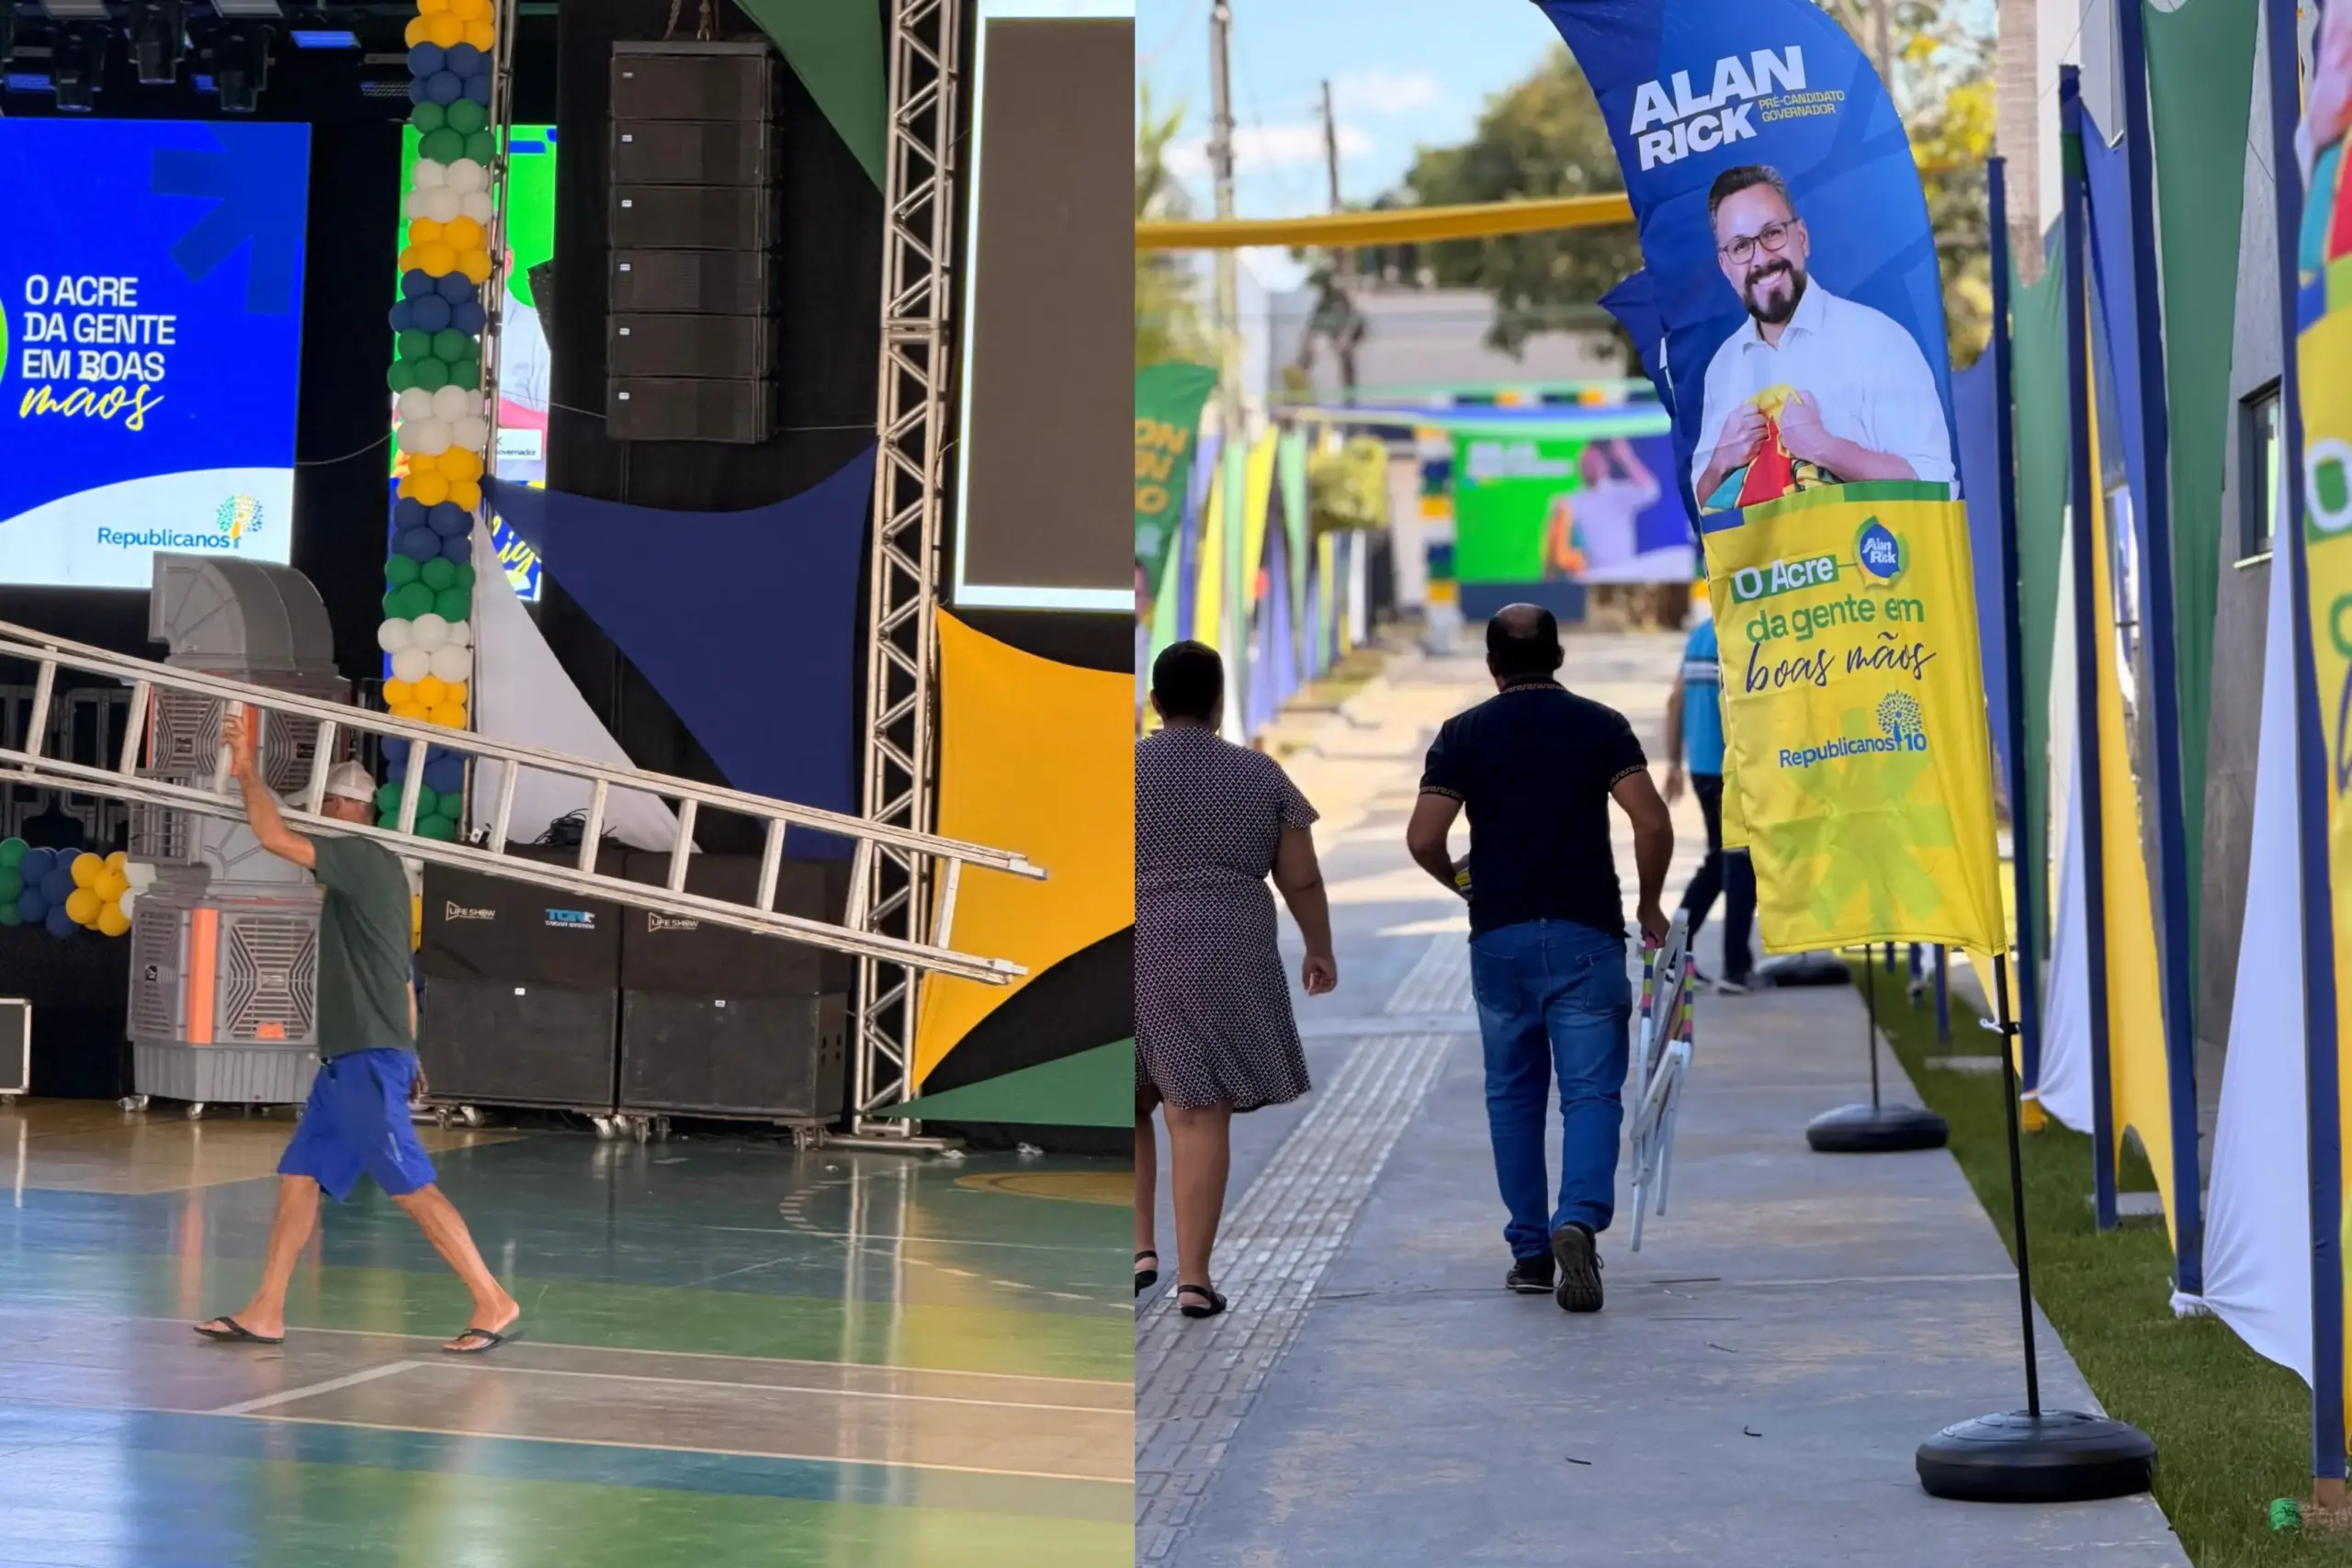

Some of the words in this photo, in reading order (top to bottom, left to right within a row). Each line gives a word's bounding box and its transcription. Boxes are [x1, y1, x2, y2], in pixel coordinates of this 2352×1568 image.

[1630, 45, 1806, 135] ALAN
[1758, 89, 1845, 110] PRÉ-CANDIDATO
[1761, 103, 1836, 122] GOVERNADOR
[1638, 101, 1757, 172] RICK
[25, 274, 48, 306] O
[53, 276, 138, 306] ACRE
[22, 311, 67, 343] DA
[73, 313, 176, 344] GENTE
[22, 349, 71, 379] EM
[76, 349, 165, 381] BOAS
[97, 526, 230, 549] Republicanos
[1861, 536, 1892, 554] Alan
[1735, 566, 1763, 598] O
[1770, 556, 1834, 593] Acre
[1746, 609, 1790, 643] da
[1792, 593, 1876, 642] gente
[1884, 597, 1925, 623] em
[1746, 641, 1836, 694] boas
[1846, 631, 1937, 681] mãos
[1779, 736, 1895, 769] Republicanos
[1905, 732, 1928, 751] 10
